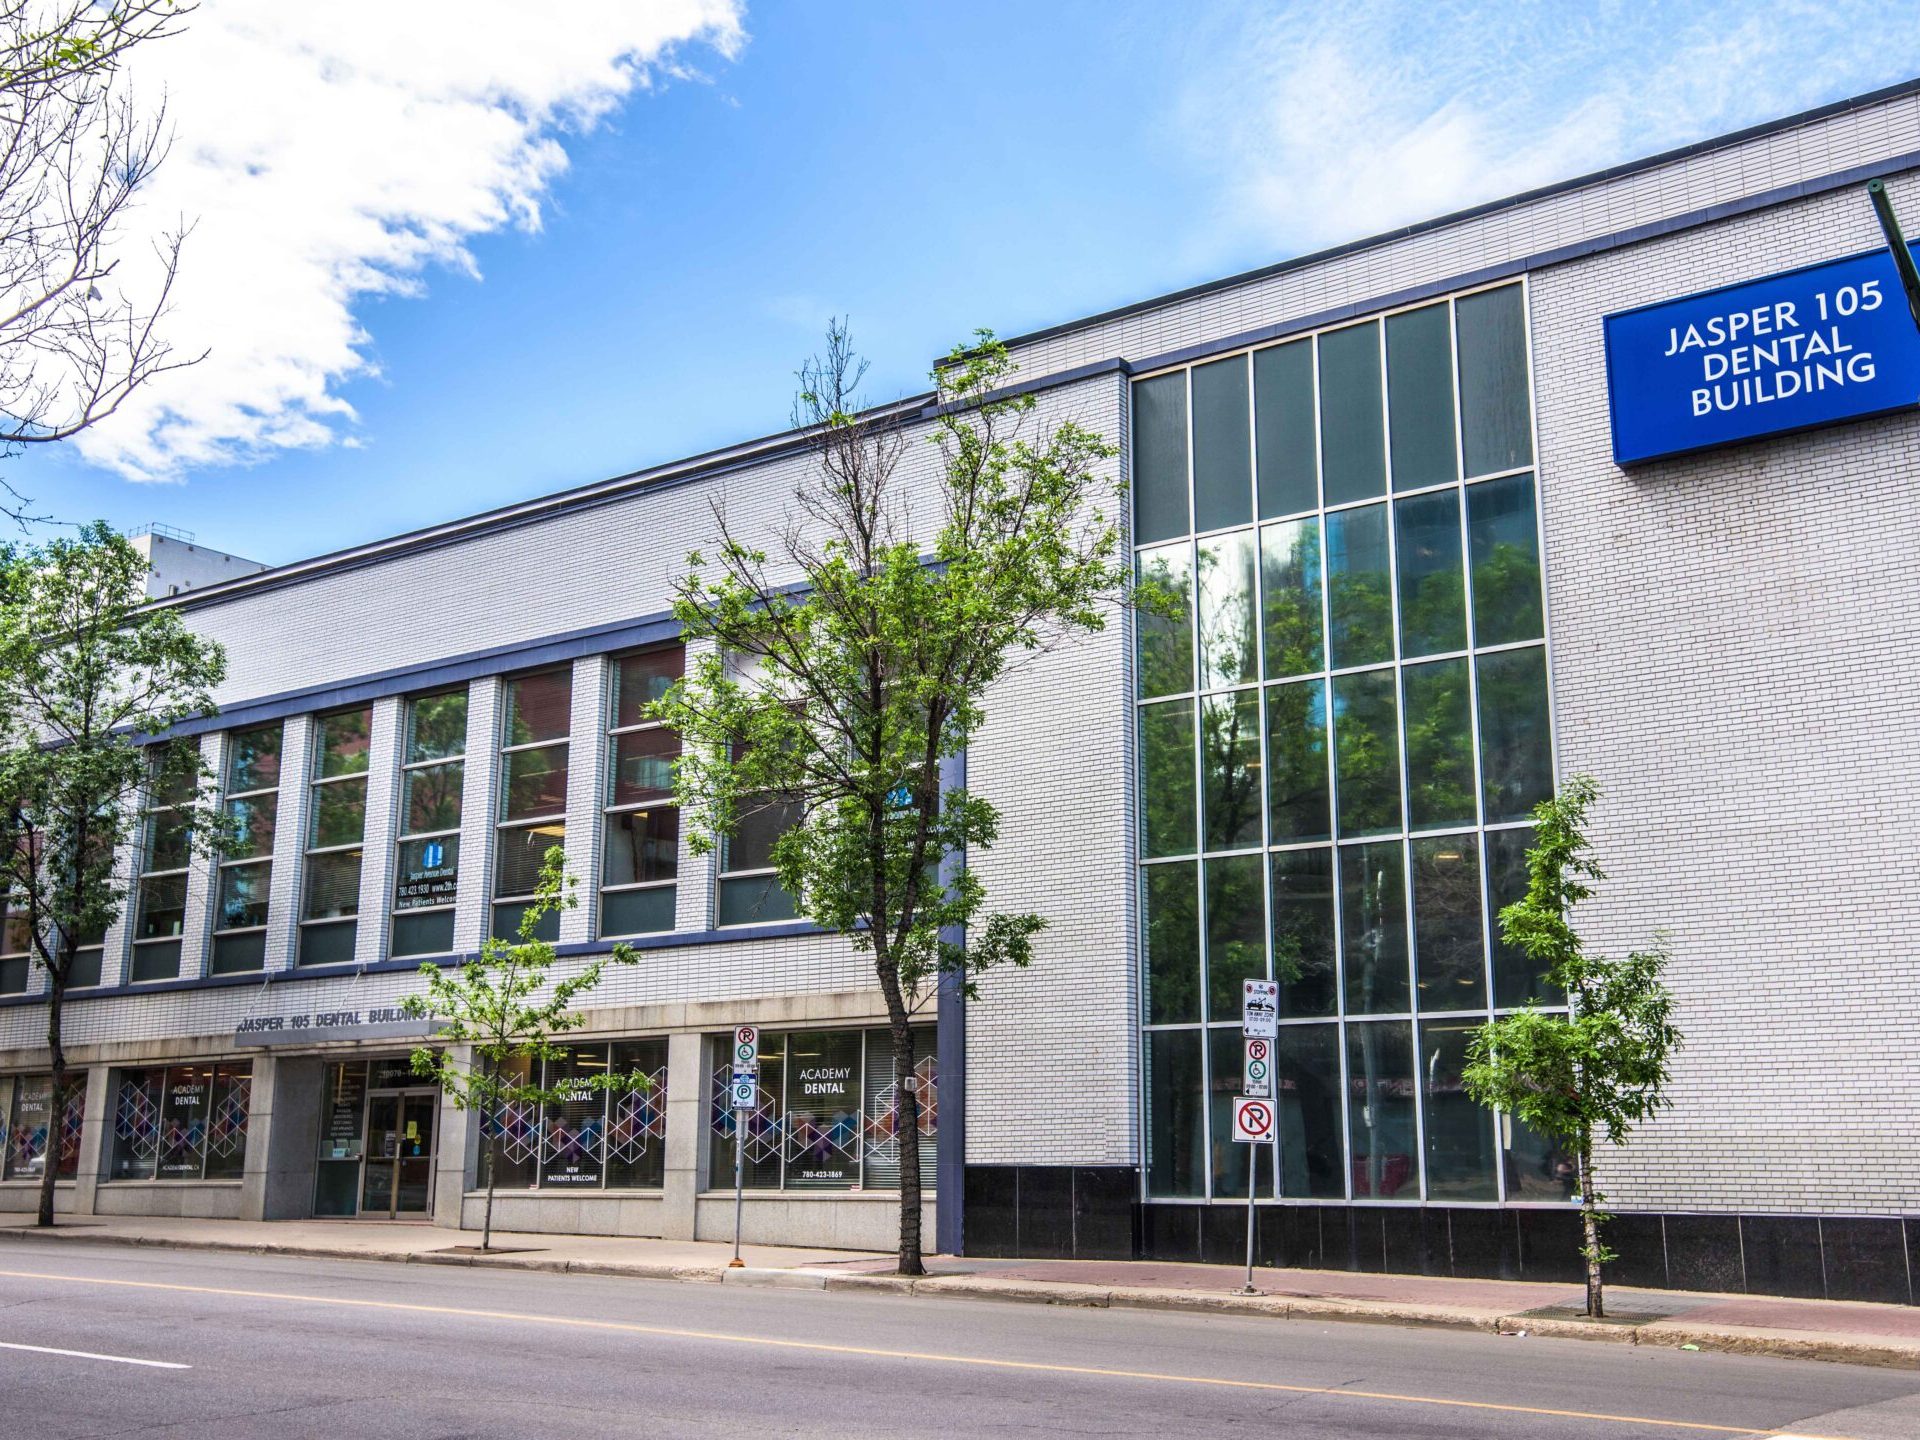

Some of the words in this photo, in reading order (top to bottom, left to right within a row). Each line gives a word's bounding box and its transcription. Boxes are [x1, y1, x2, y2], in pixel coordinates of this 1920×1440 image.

[1664, 301, 1800, 357] JASPER
[1815, 279, 1884, 321] 105
[1703, 326, 1853, 382] DENTAL
[1691, 352, 1876, 417] BUILDING
[411, 897, 435, 907] Patients
[240, 1016, 284, 1032] JASPER
[290, 1014, 310, 1029] 105
[315, 1011, 362, 1028] DENTAL
[799, 1067, 851, 1080] ACADEMY
[555, 1077, 594, 1089] ACADEM
[804, 1082, 845, 1094] DENTAL
[172, 1084, 205, 1095] ACADEMY
[175, 1095, 200, 1106] DENTAL
[21, 1103, 44, 1112] DENTAL
[571, 1174, 598, 1182] WELCOME
